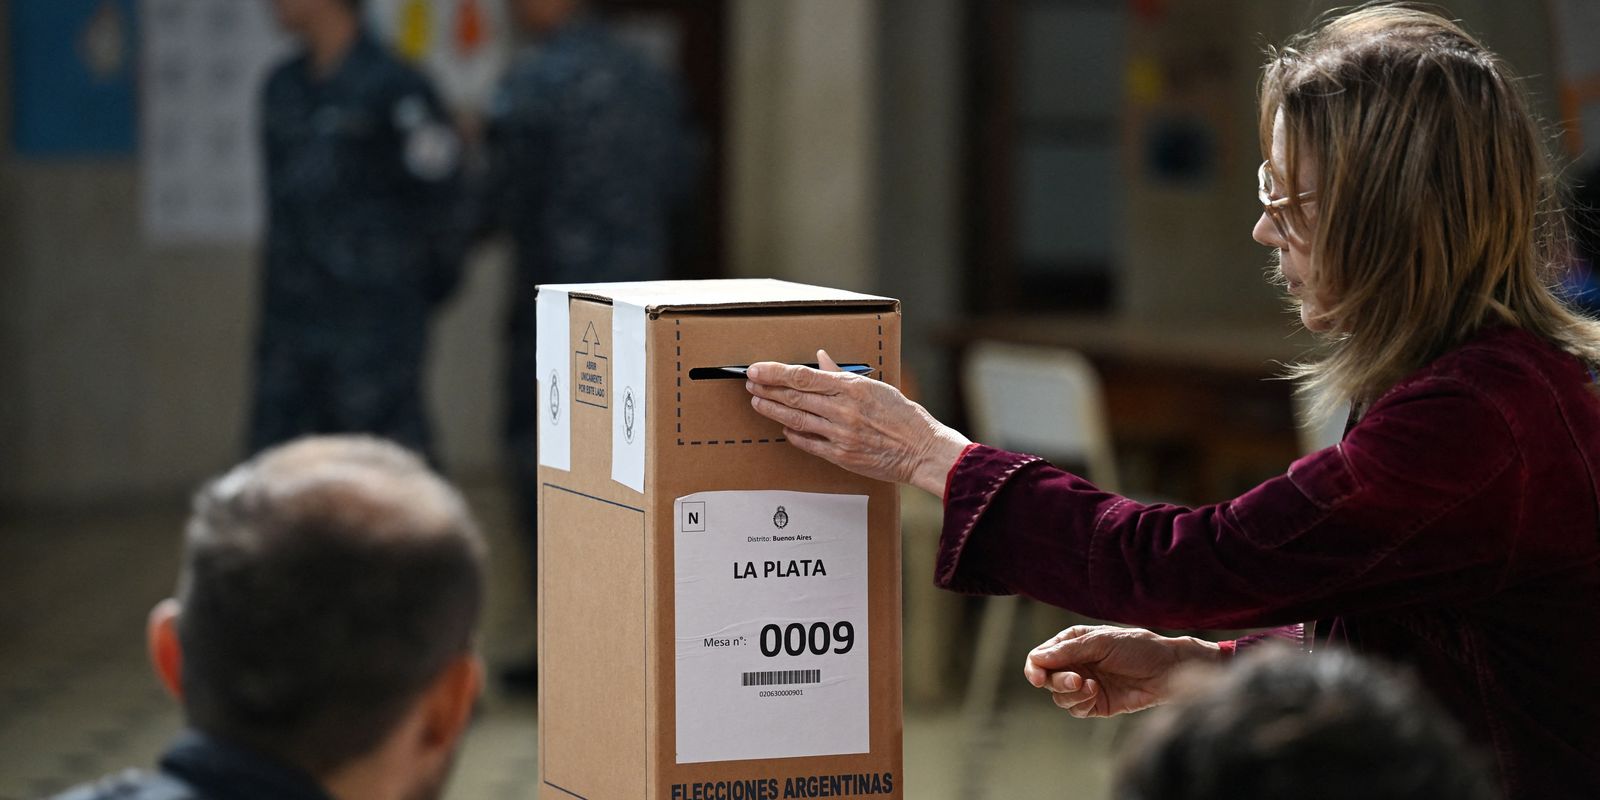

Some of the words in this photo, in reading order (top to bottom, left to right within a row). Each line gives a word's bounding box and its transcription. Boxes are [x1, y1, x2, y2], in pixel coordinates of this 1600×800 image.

[586, 361, 597, 370] ABRIR
[578, 384, 586, 392] POR
[586, 385, 595, 395] ESTE
[595, 387, 605, 398] LADO
[688, 512, 699, 524] N
[747, 535, 771, 543] Distrito:
[733, 561, 757, 579] LA
[764, 559, 827, 578] PLATA
[703, 638, 730, 647] Mesa
[759, 621, 855, 657] 0009
[759, 689, 804, 698] 020630000901
[671, 778, 779, 800] ELECCIONES
[783, 772, 893, 799] ARGENTINAS
